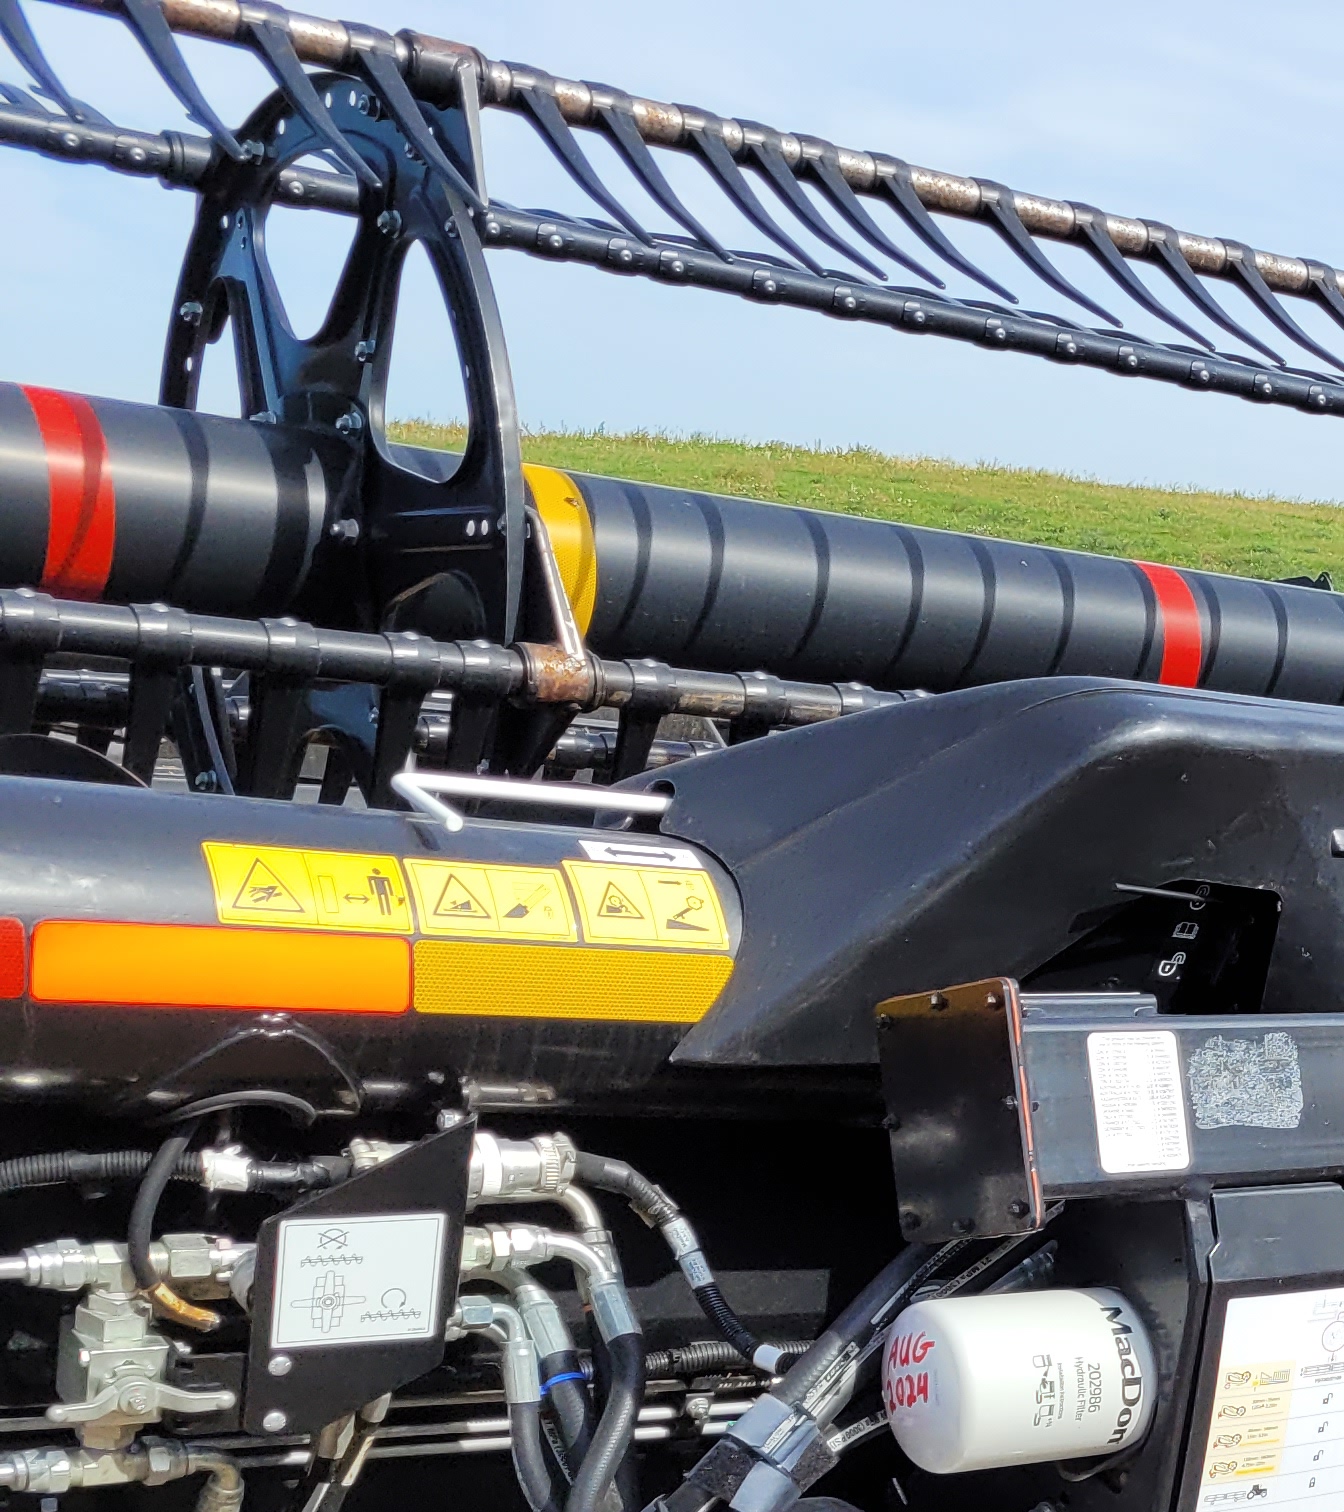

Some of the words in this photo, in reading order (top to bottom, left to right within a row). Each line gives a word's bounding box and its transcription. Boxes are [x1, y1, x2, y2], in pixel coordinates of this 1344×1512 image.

[886, 1330, 936, 1377] AUG
[1100, 1306, 1142, 1445] MacDon
[886, 1371, 929, 1416] 2024
[1073, 1356, 1087, 1399] Hydraulic
[1087, 1362, 1102, 1413] 202986
[1074, 1400, 1087, 1421] Filter
